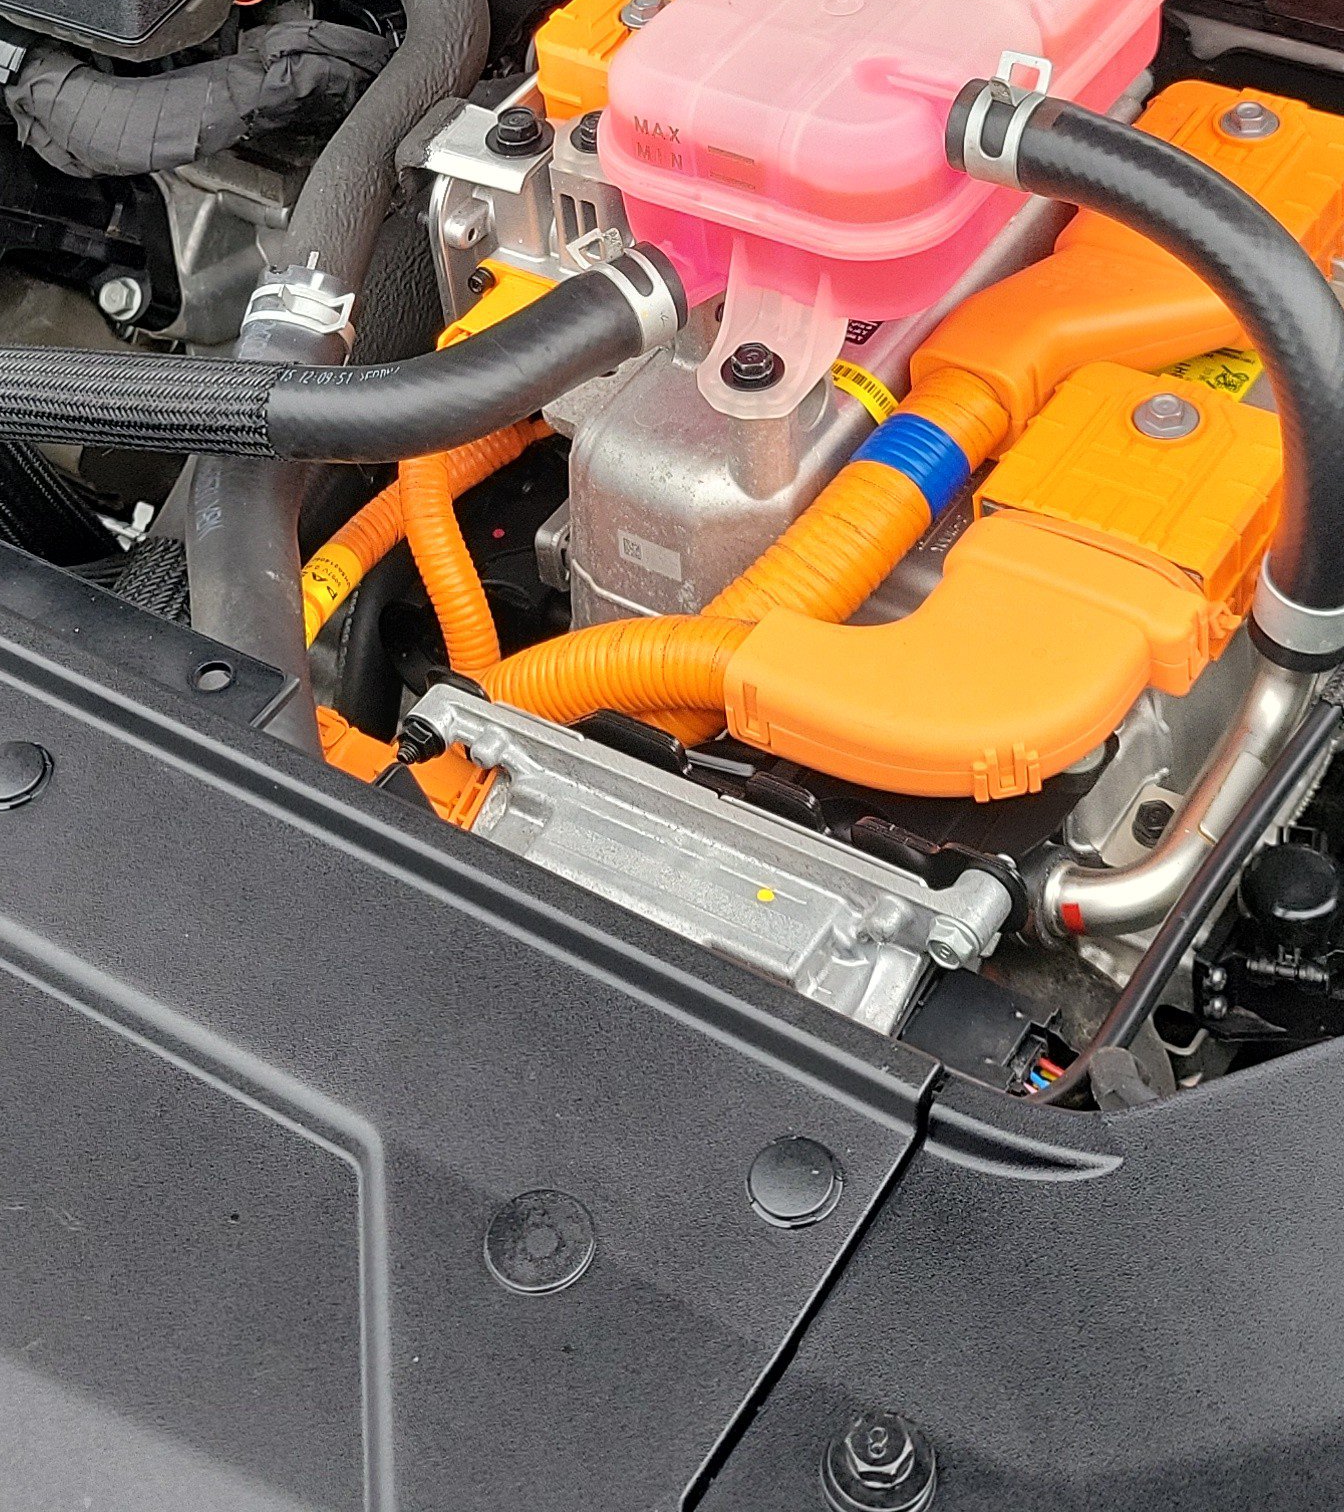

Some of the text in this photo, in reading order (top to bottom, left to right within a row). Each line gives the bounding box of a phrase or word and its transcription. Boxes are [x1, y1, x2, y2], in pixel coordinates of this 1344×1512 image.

[634, 115, 681, 144] MAX
[637, 142, 682, 170] MIN
[298, 371, 354, 385] 12:09:51
